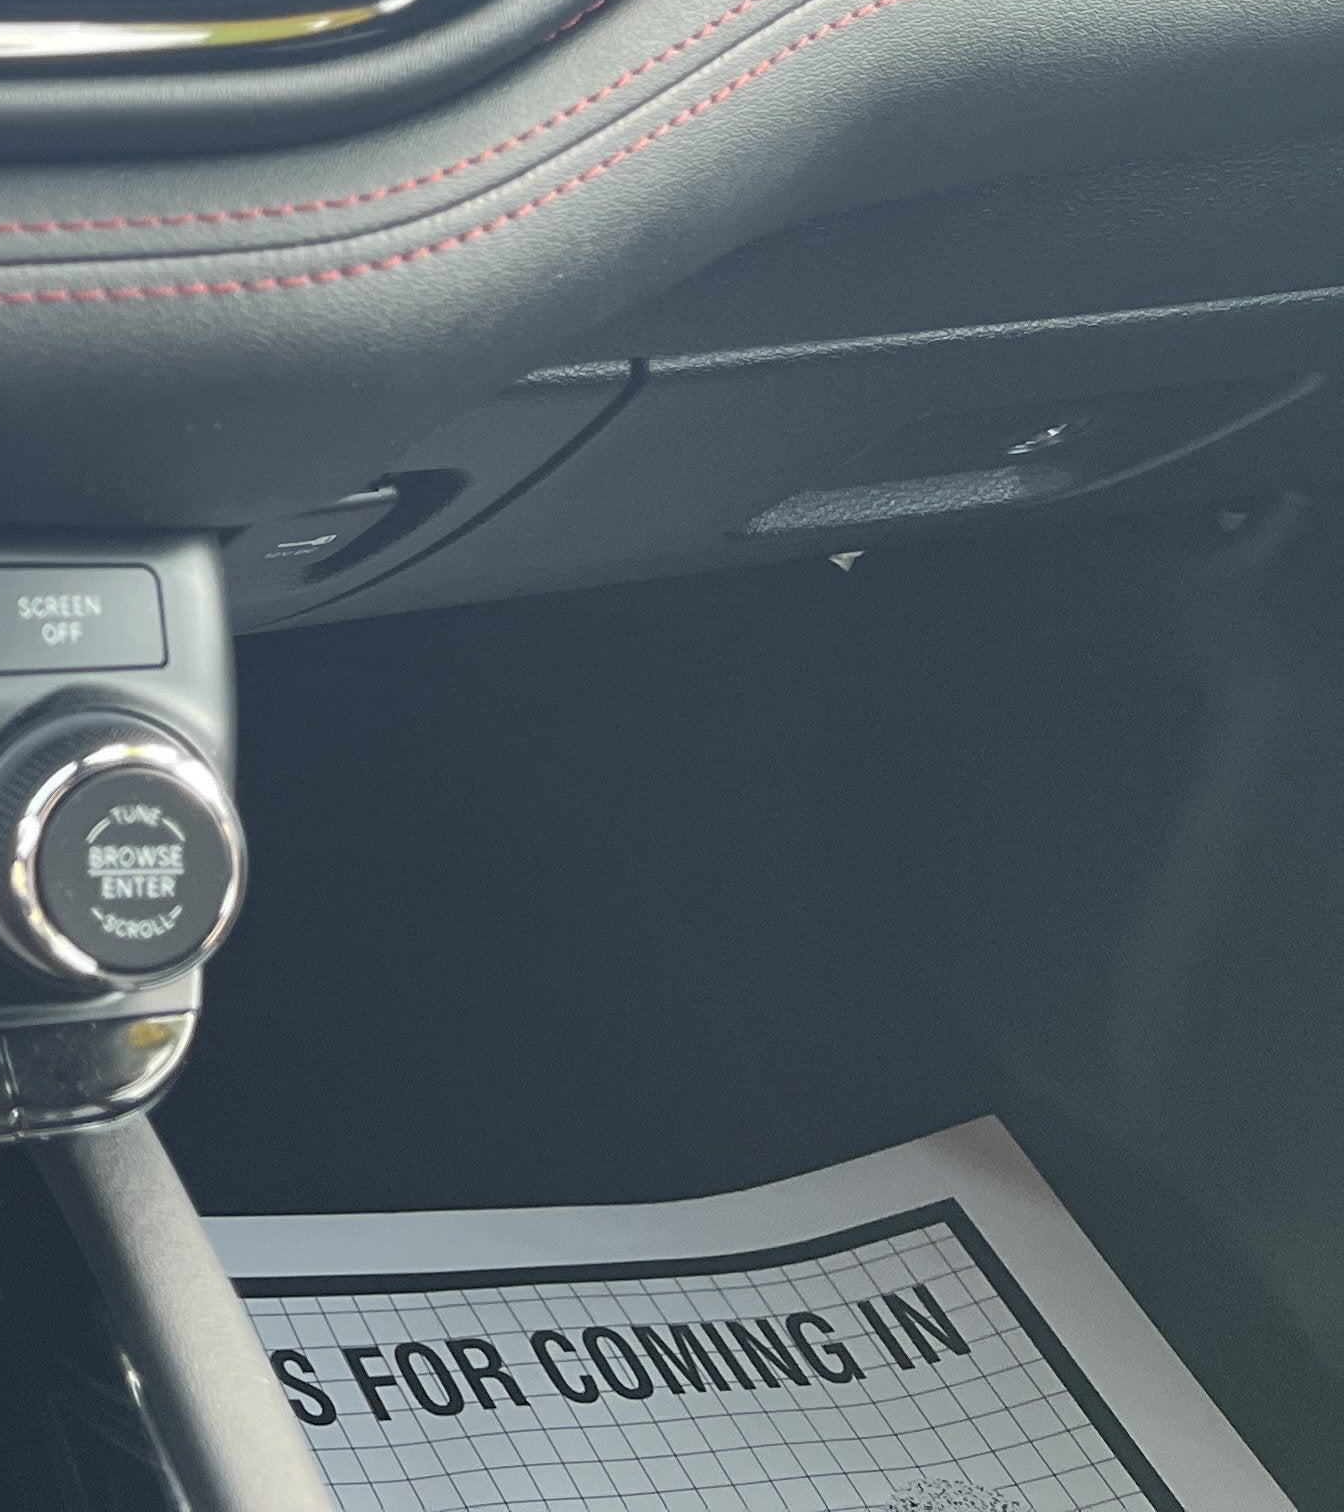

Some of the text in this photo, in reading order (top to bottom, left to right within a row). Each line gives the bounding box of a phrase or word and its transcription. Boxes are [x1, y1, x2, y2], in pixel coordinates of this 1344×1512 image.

[16, 593, 102, 619] SCREEN
[39, 620, 84, 646] OFF
[110, 803, 161, 827] TUNE
[88, 844, 184, 868] BROWSE
[100, 875, 178, 899] ENTER
[102, 914, 176, 939] SCROLL
[342, 1338, 531, 1422] FOR
[530, 1308, 867, 1404] COMING
[856, 1282, 972, 1370] IN
